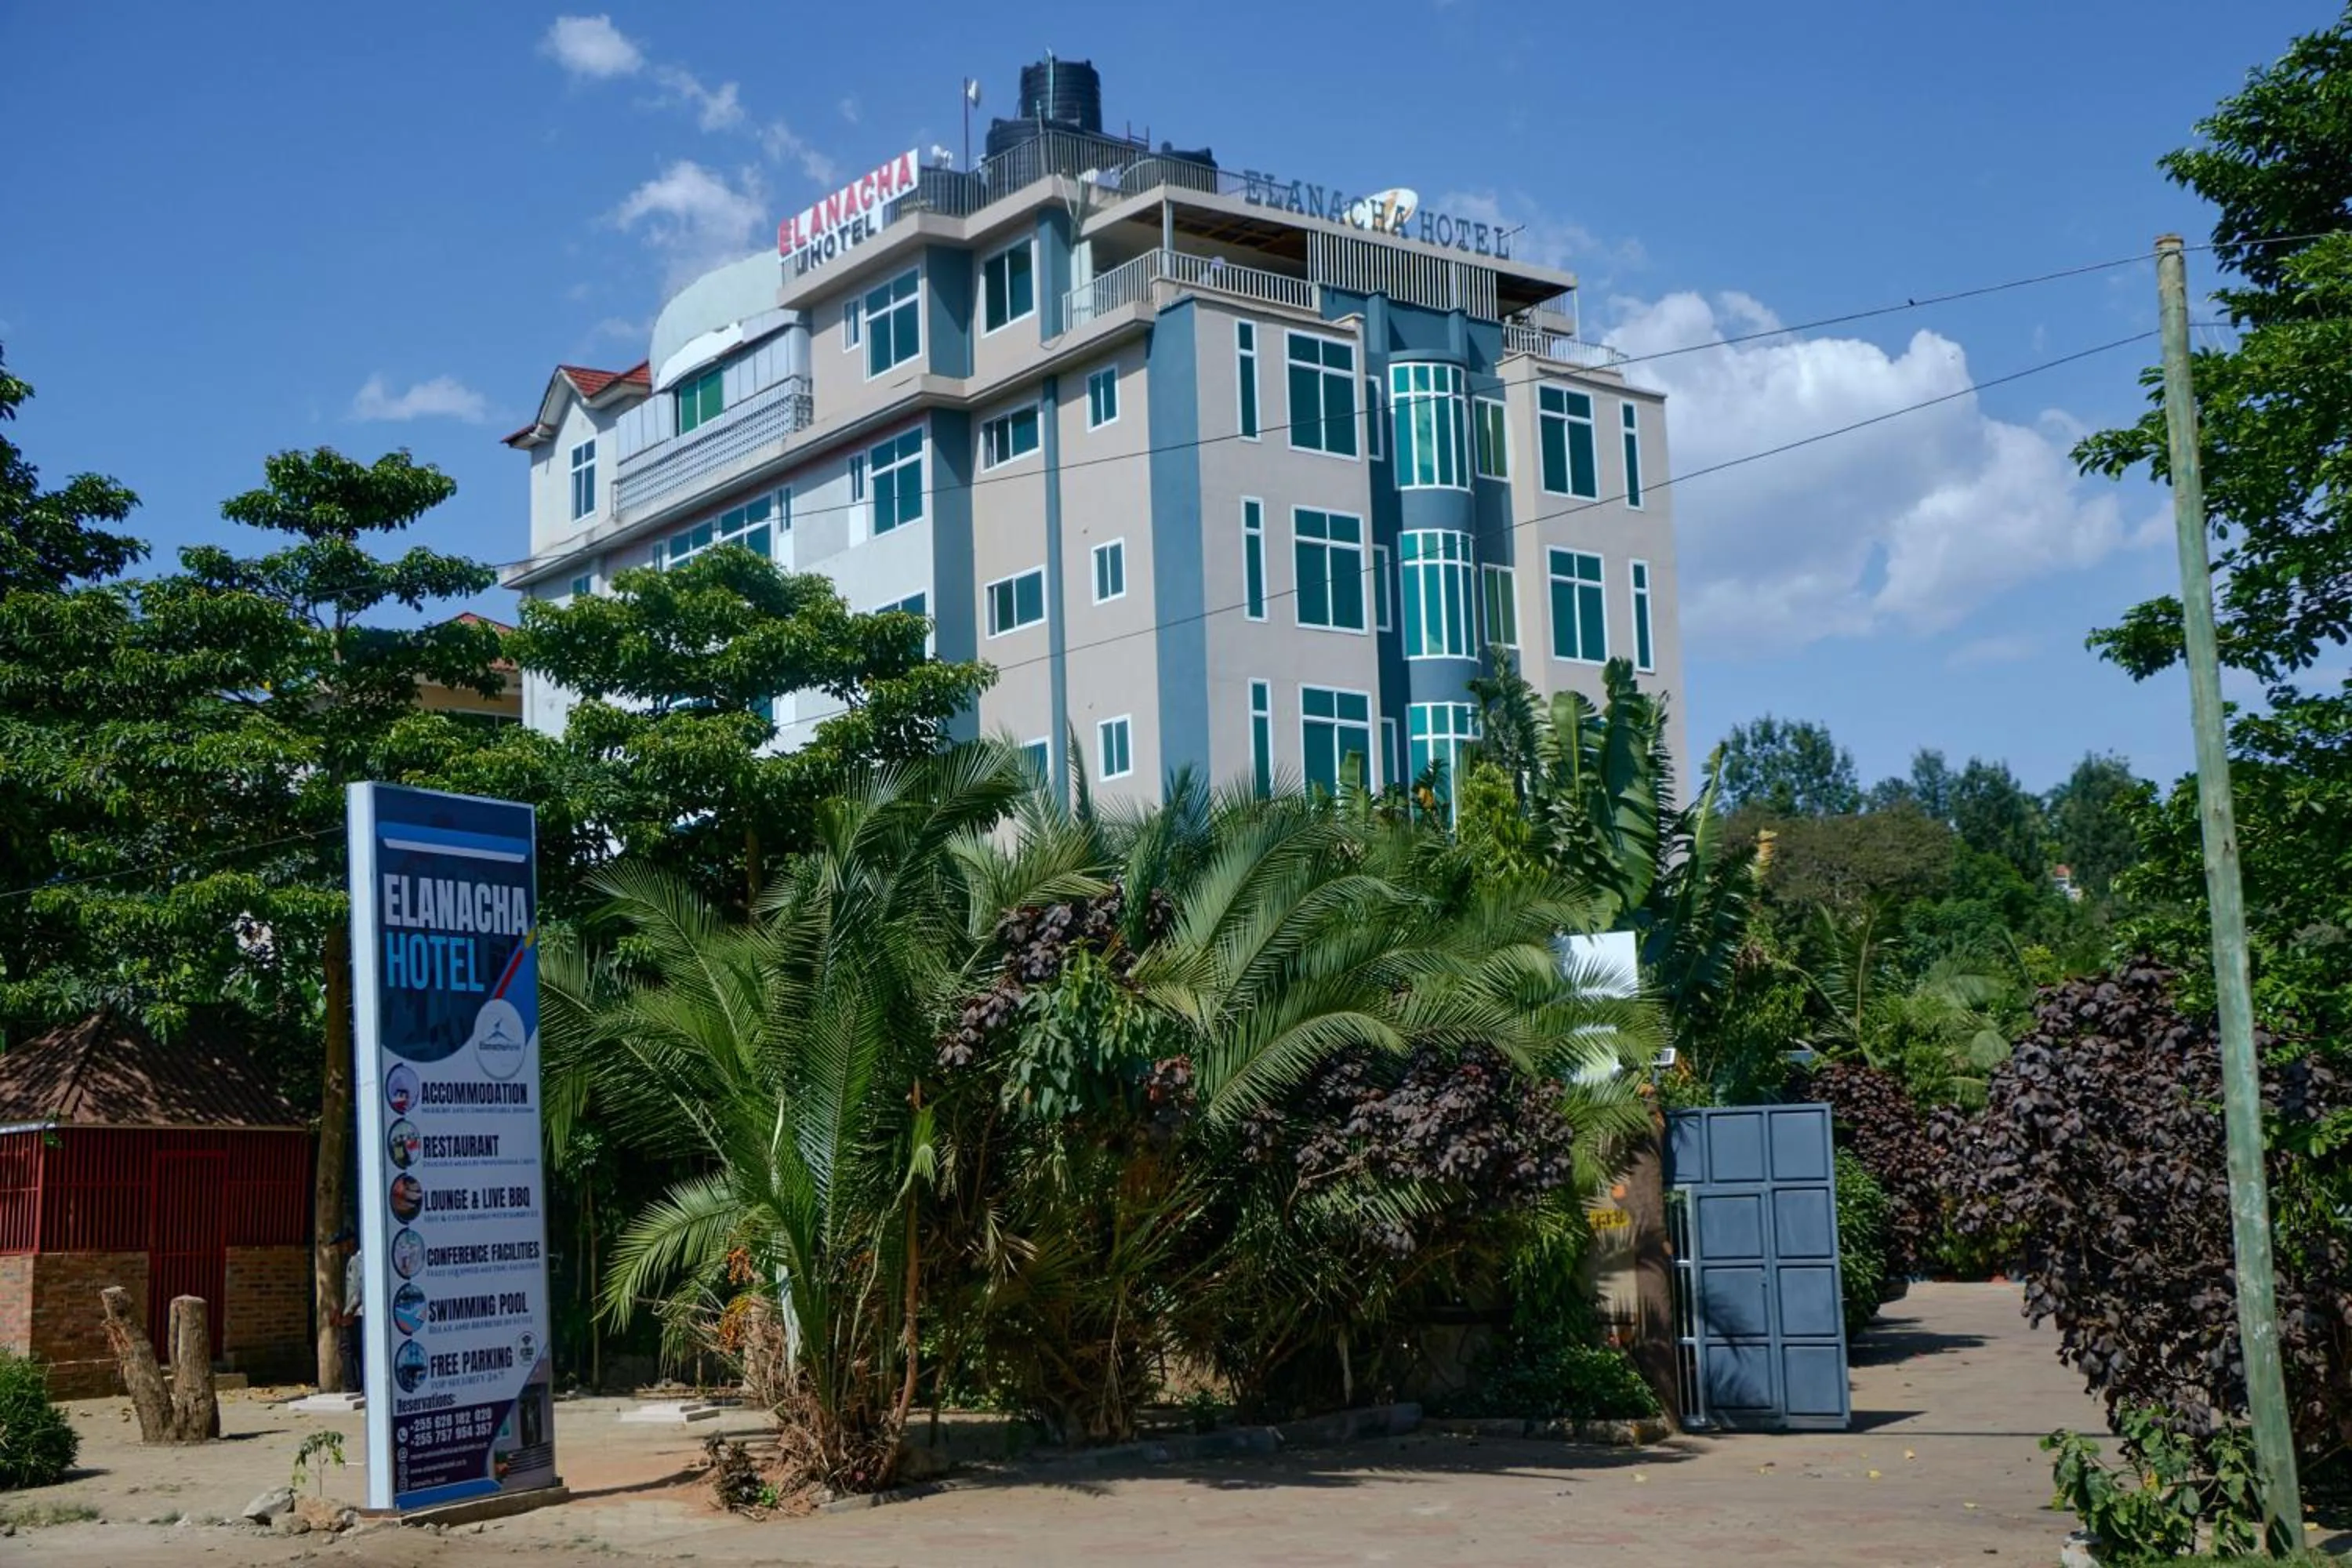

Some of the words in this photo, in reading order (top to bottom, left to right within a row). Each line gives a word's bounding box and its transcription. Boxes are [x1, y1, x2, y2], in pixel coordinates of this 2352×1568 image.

[778, 151, 913, 257] ELANACHA
[1243, 169, 1409, 238] ELANACHA
[1419, 210, 1510, 259] HOTEL
[810, 214, 876, 268] HOTEL
[383, 873, 528, 936] ELANACHA
[387, 931, 485, 992] HOTEL
[422, 1082, 528, 1105] ACCOMMODATION
[423, 1134, 499, 1158] RESTAURANT
[424, 1189, 468, 1211] LOUNGE
[472, 1191, 478, 1209] &
[482, 1187, 506, 1208] LIVE
[509, 1186, 530, 1207] BBQ
[426, 1244, 489, 1267] CONFERENCE
[491, 1241, 540, 1261] FACILITIES
[429, 1294, 495, 1323] SWIMMING
[500, 1291, 529, 1316] POOL
[430, 1352, 459, 1378] FREE
[463, 1346, 513, 1374] PARKING
